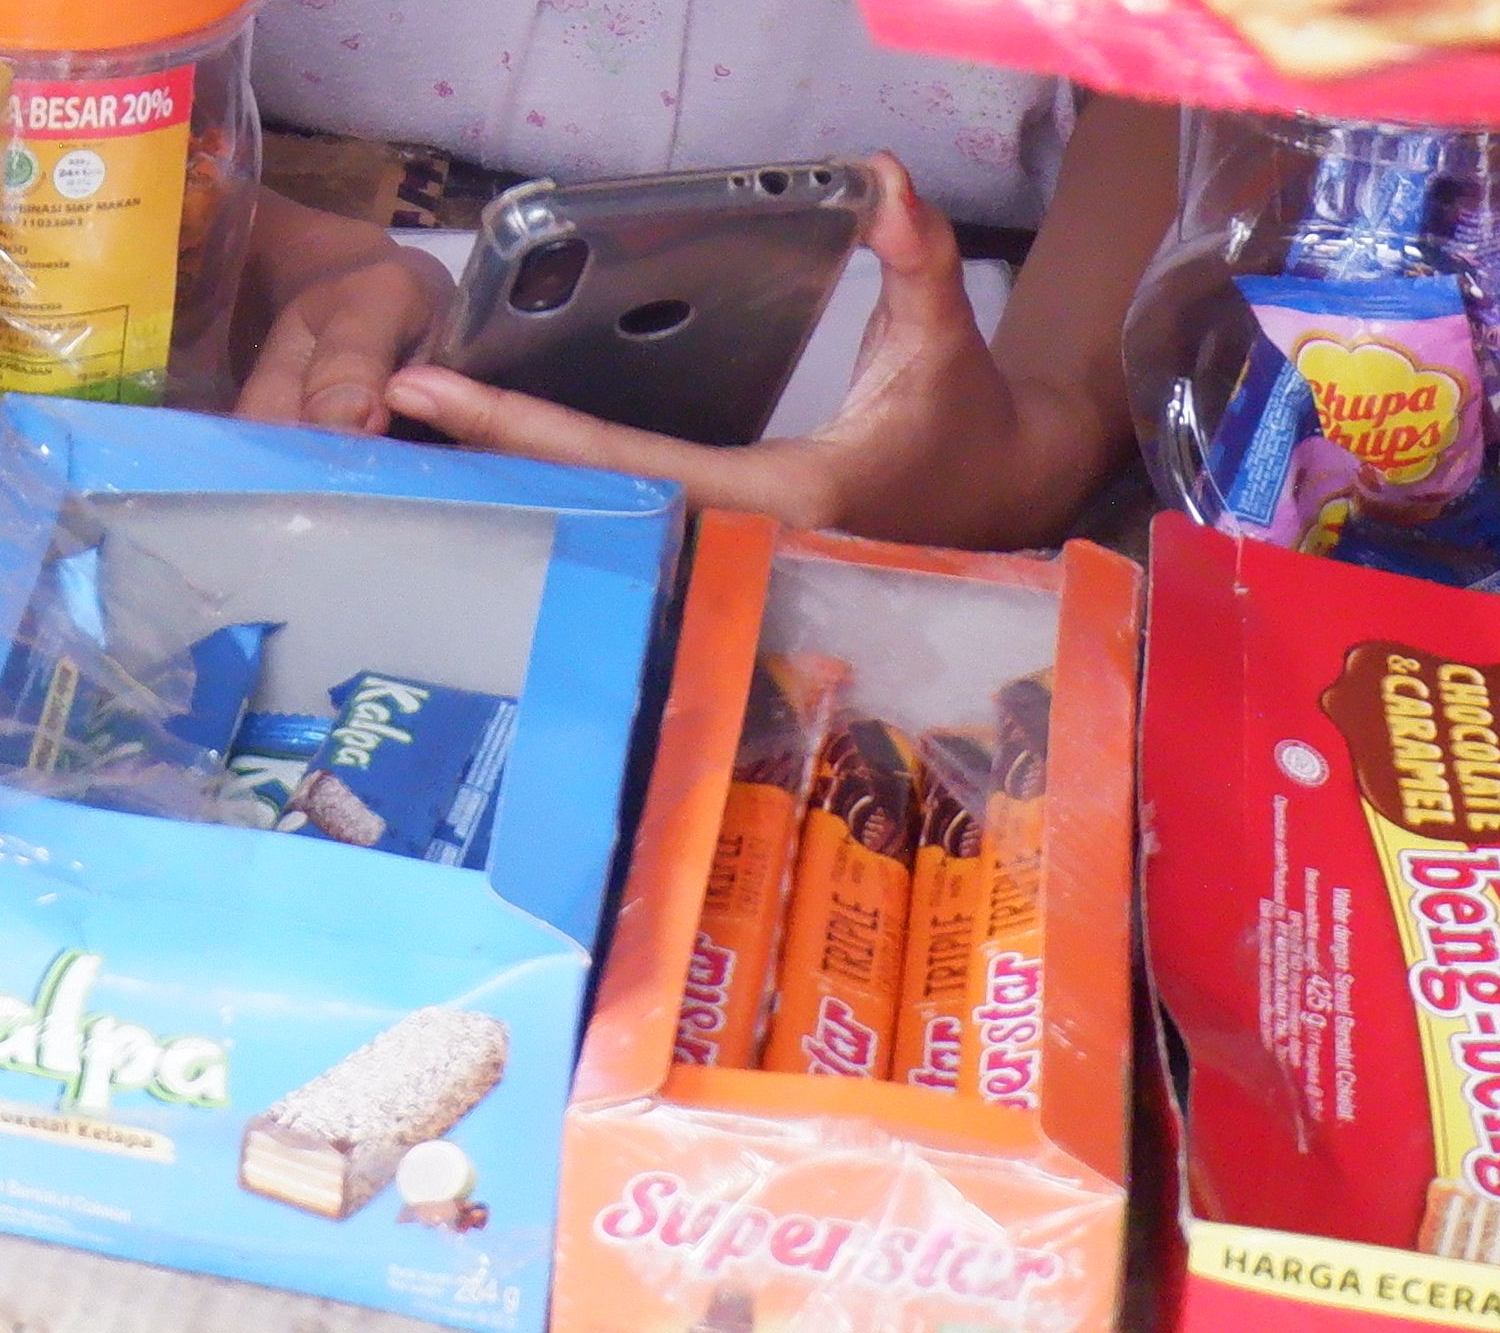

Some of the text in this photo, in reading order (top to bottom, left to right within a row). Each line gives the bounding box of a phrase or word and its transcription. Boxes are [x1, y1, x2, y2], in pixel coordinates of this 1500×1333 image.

[27, 83, 175, 135] BESAR 20%
[332, 672, 432, 771] Kalpa
[1380, 652, 1455, 826] & CARAMEL
[820, 891, 883, 986] TRIPLE
[924, 910, 976, 1000] TRIPLE
[599, 1169, 1062, 1305] Superstar
[1221, 1242, 1366, 1297] HARGA
